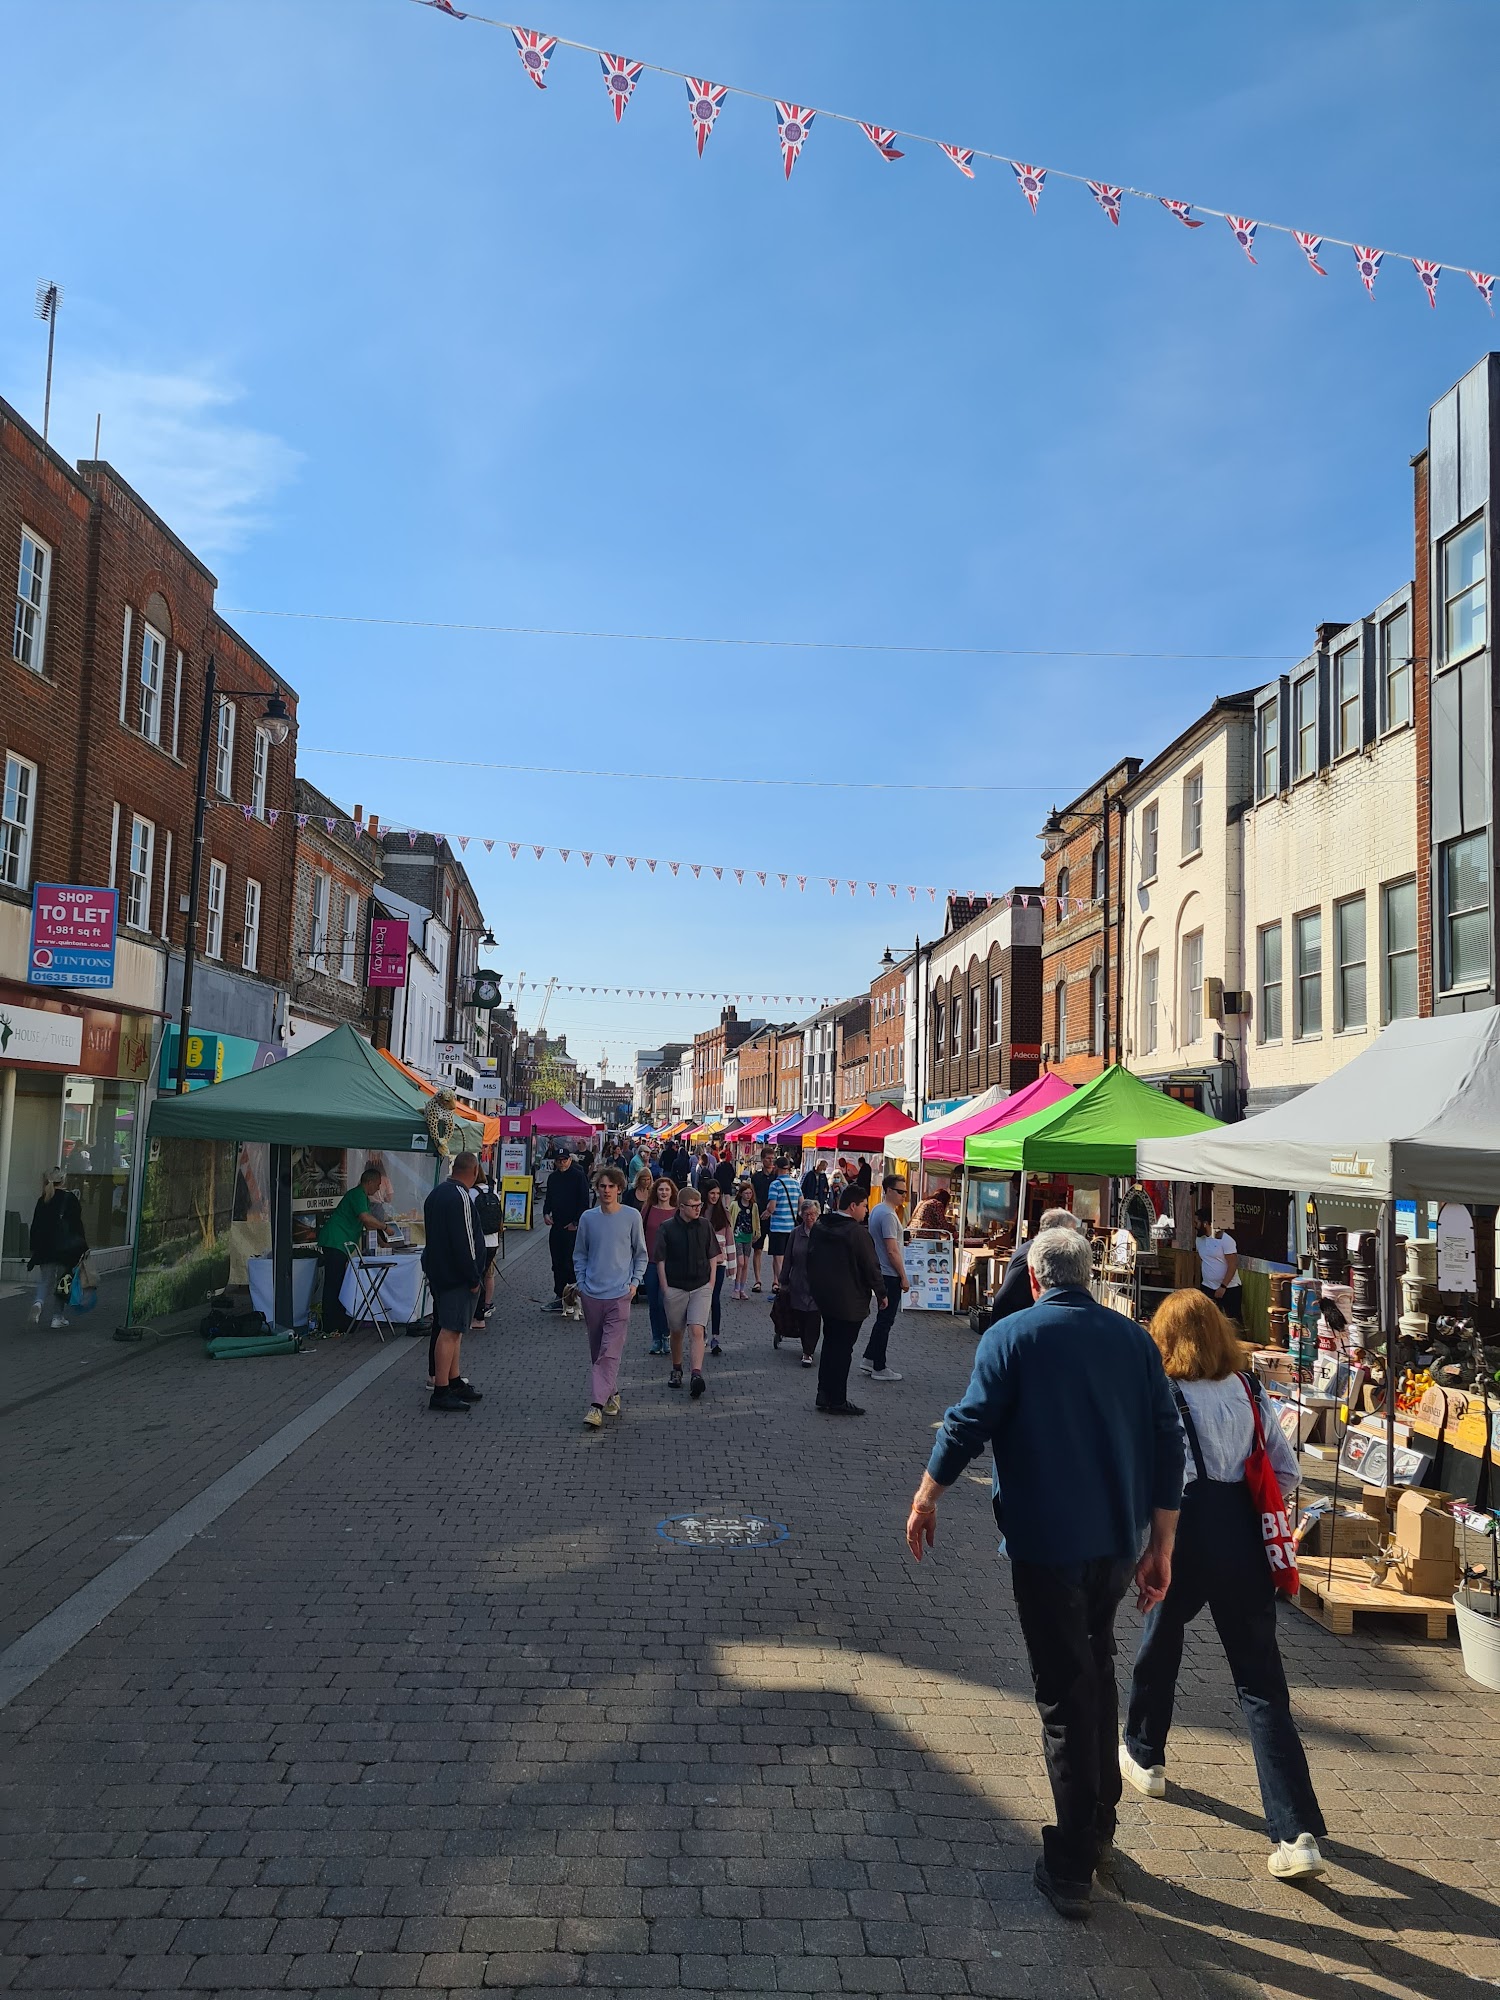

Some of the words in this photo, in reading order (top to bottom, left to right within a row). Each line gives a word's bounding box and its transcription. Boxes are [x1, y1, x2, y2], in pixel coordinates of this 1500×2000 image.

[58, 892, 94, 903] SHOP
[39, 905, 67, 921] TO
[72, 907, 110, 923] LET
[46, 925, 74, 935] 1,981
[77, 928, 90, 937] sq
[92, 928, 101, 936] ft
[37, 939, 110, 948] www.quintons.co.uk
[372, 926, 388, 973] Parkway
[33, 948, 111, 969] QUINTONS
[33, 972, 68, 982] 01635
[71, 974, 108, 984] 551441
[14, 1028, 40, 1043] HOUSE
[51, 1034, 74, 1048] TWEED
[438, 1052, 460, 1061] iTech
[1013, 1051, 1039, 1059] Adecco
[306, 1199, 318, 1208] OUR
[318, 1198, 334, 1208] HOME
[686, 1530, 760, 1538] STAY
